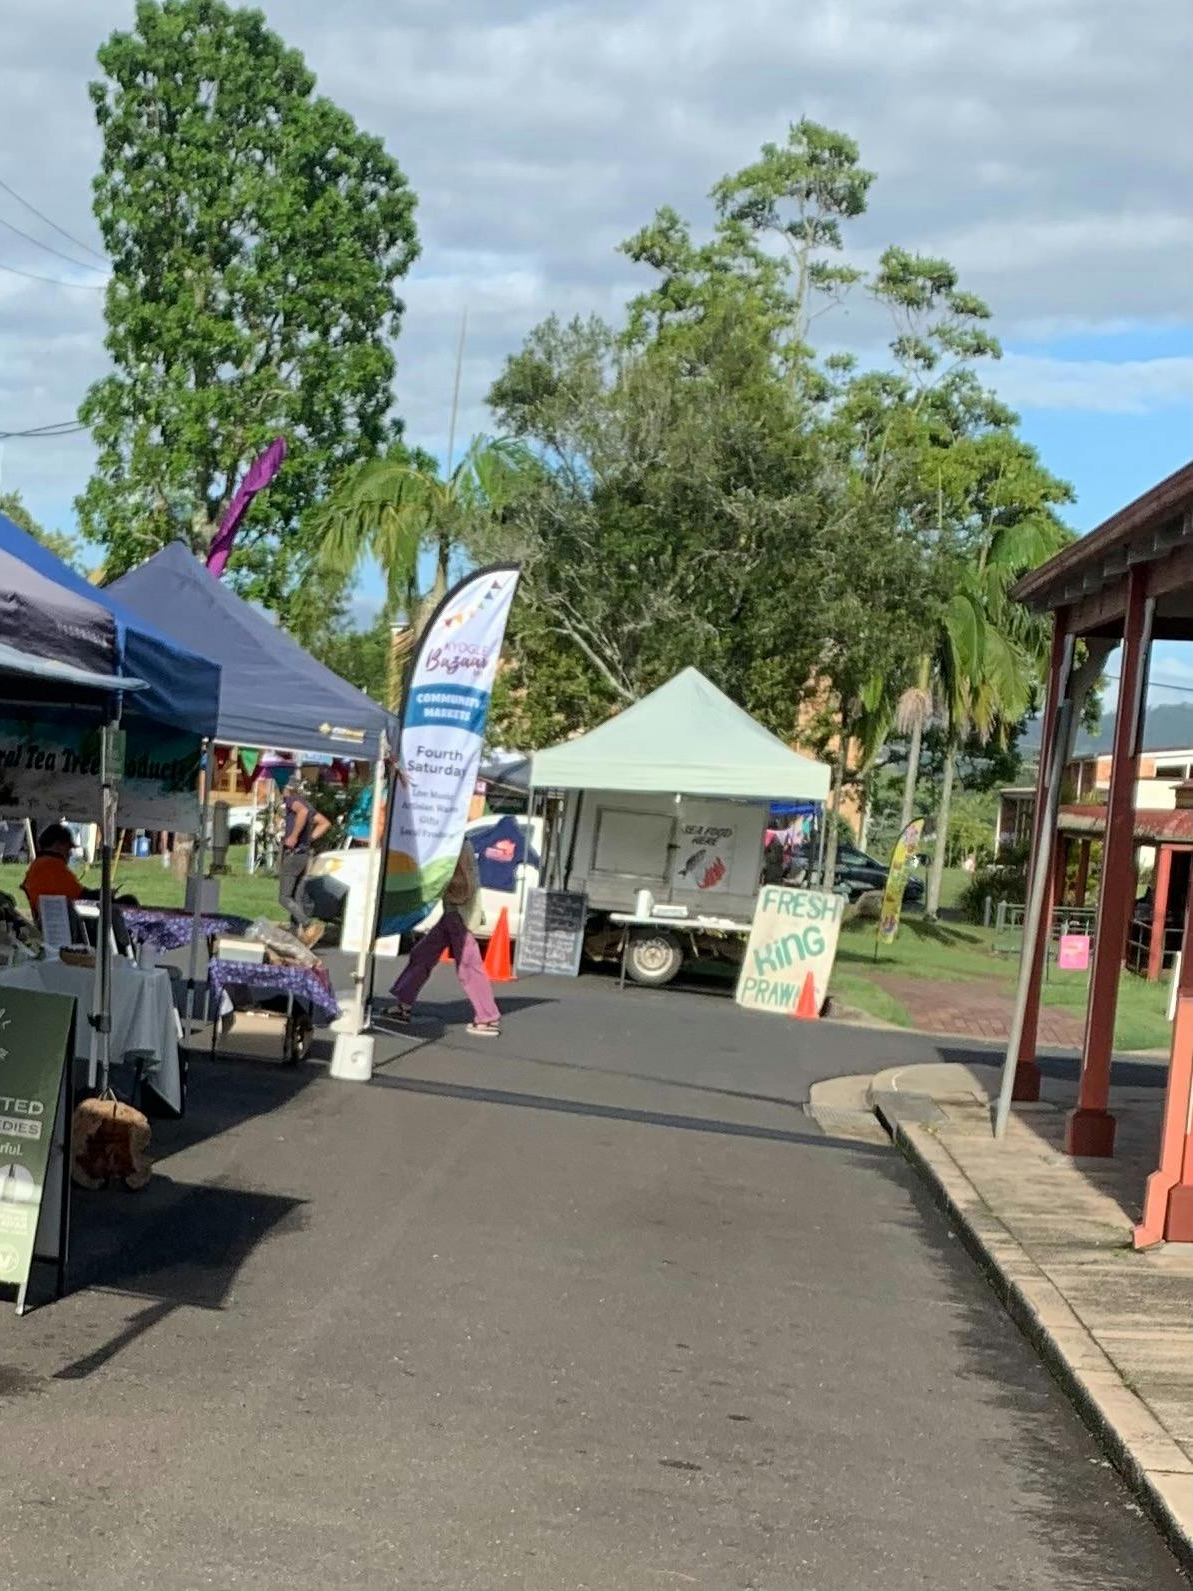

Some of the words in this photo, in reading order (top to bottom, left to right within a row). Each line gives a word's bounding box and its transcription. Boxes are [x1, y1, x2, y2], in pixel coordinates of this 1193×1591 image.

[416, 693, 480, 708] COMMUNITY
[423, 707, 471, 721] MARKETS
[25, 744, 57, 771] Tea
[61, 748, 101, 776] Tree
[416, 745, 463, 761] Fourth
[407, 760, 467, 778] Saturday
[762, 888, 840, 923] FRESH
